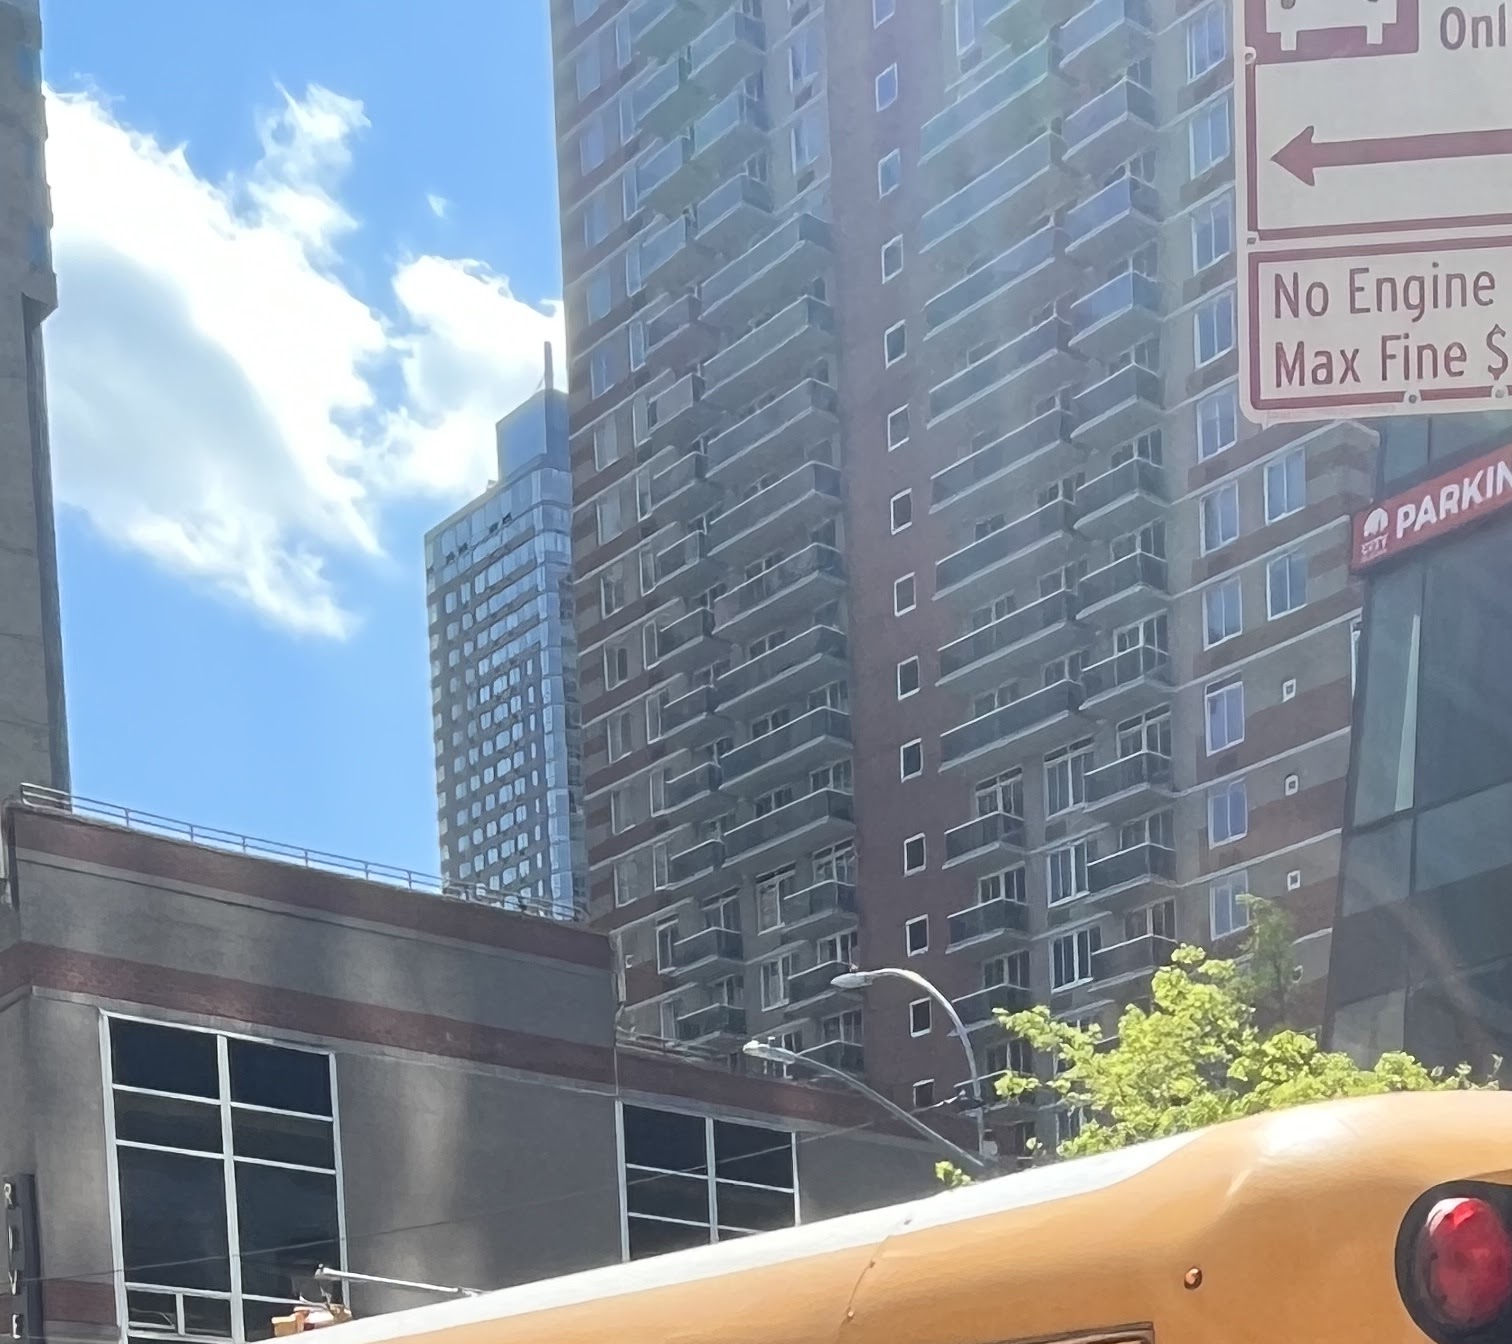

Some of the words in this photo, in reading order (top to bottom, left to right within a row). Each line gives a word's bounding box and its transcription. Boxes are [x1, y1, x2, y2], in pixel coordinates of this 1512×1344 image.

[1274, 271, 1329, 319] No
[1349, 261, 1496, 322] Engine
[1275, 341, 1361, 388] Max
[1381, 332, 1468, 382] Fine
